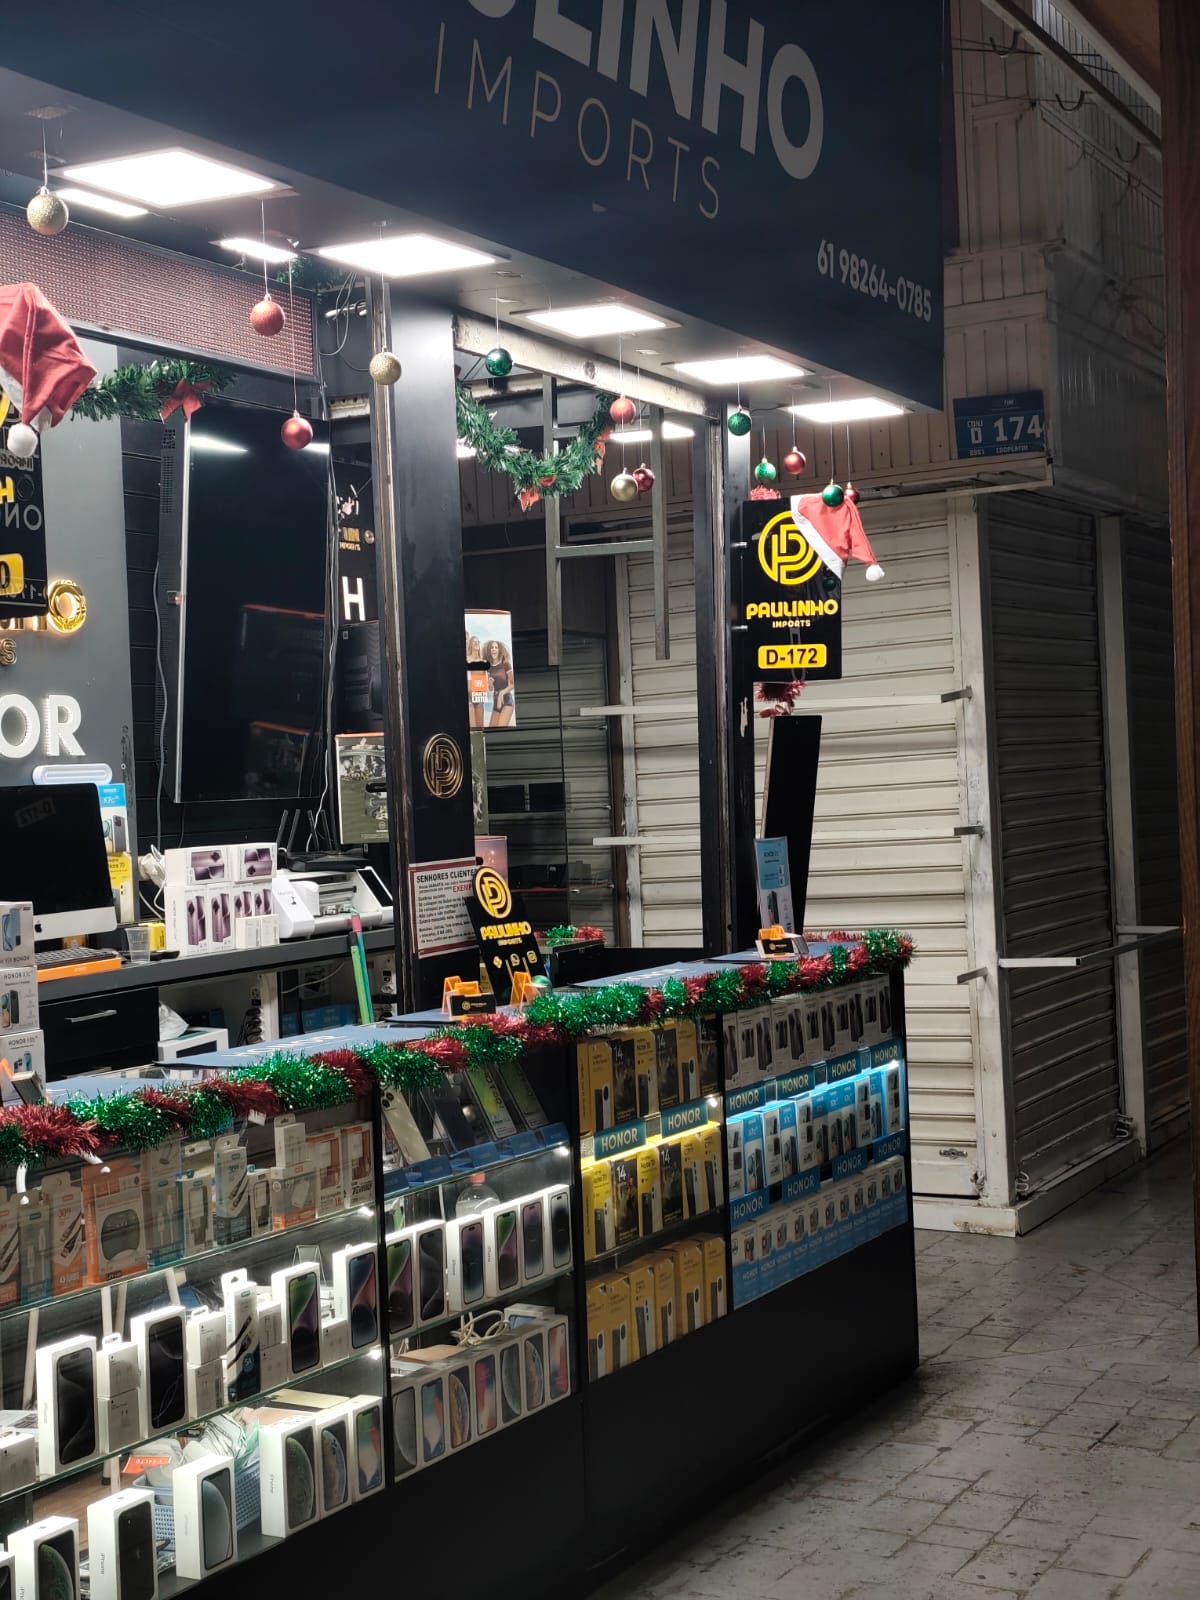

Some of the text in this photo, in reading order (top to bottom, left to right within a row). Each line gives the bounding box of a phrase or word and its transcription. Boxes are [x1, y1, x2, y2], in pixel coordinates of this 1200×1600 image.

[434, 22, 722, 219] IMPORTS
[816, 239, 932, 322] 61 98264-0785
[994, 414, 1042, 442] 174
[746, 598, 839, 619] PAULINHO
[772, 620, 811, 628] IMPORTS
[765, 647, 818, 665] D-172
[417, 872, 448, 882] SENHORES
[480, 921, 532, 940] PAULINHO
[874, 1045, 898, 1061] HONOR
[831, 1057, 857, 1075] HONOR
[781, 1074, 809, 1093] HONOR
[729, 1090, 760, 1111] HONOR
[667, 1107, 701, 1131] HONOR
[601, 1128, 638, 1153] HONOR
[878, 1136, 901, 1156] HONOR
[837, 1153, 862, 1175] HONOR
[787, 1174, 815, 1197] HONOR
[733, 1195, 764, 1219] HONOR
